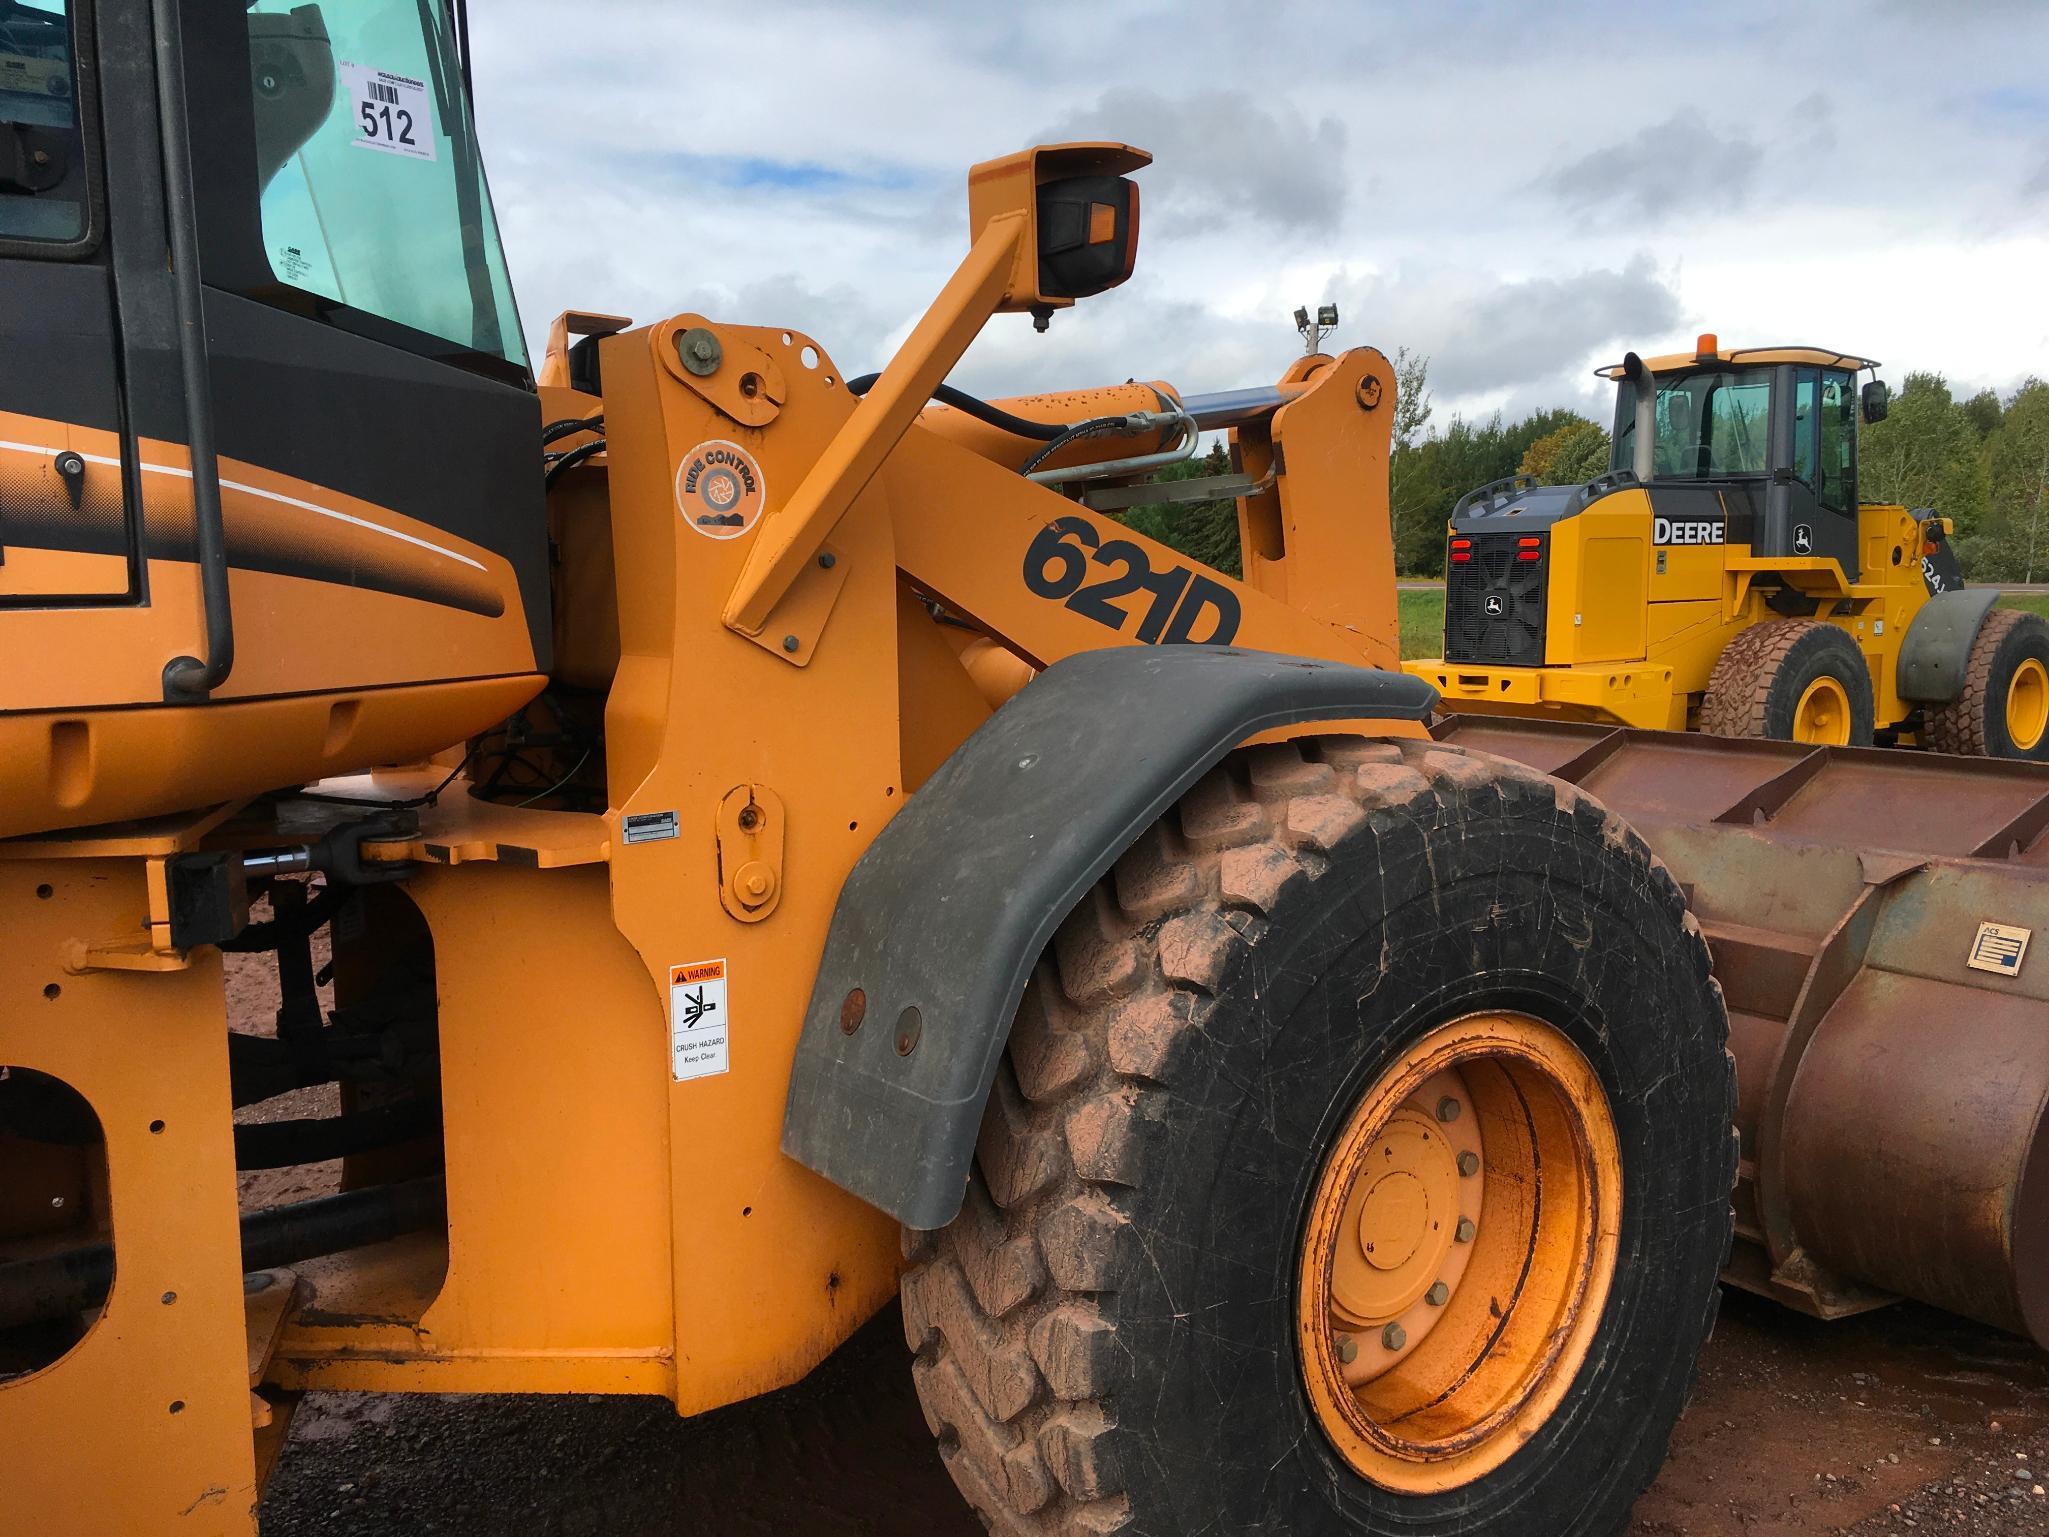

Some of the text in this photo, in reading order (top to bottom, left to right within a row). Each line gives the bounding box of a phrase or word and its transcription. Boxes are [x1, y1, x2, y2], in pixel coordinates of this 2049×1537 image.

[361, 101, 415, 146] 512
[685, 449, 756, 497] RIDE CONTROL
[1653, 517, 1725, 544] DEERE
[1022, 516, 1241, 645] 621D
[688, 965, 721, 981] WARNING
[675, 1037, 725, 1053] CRUSH HAZARD
[684, 1052, 716, 1064] Keep Clear
